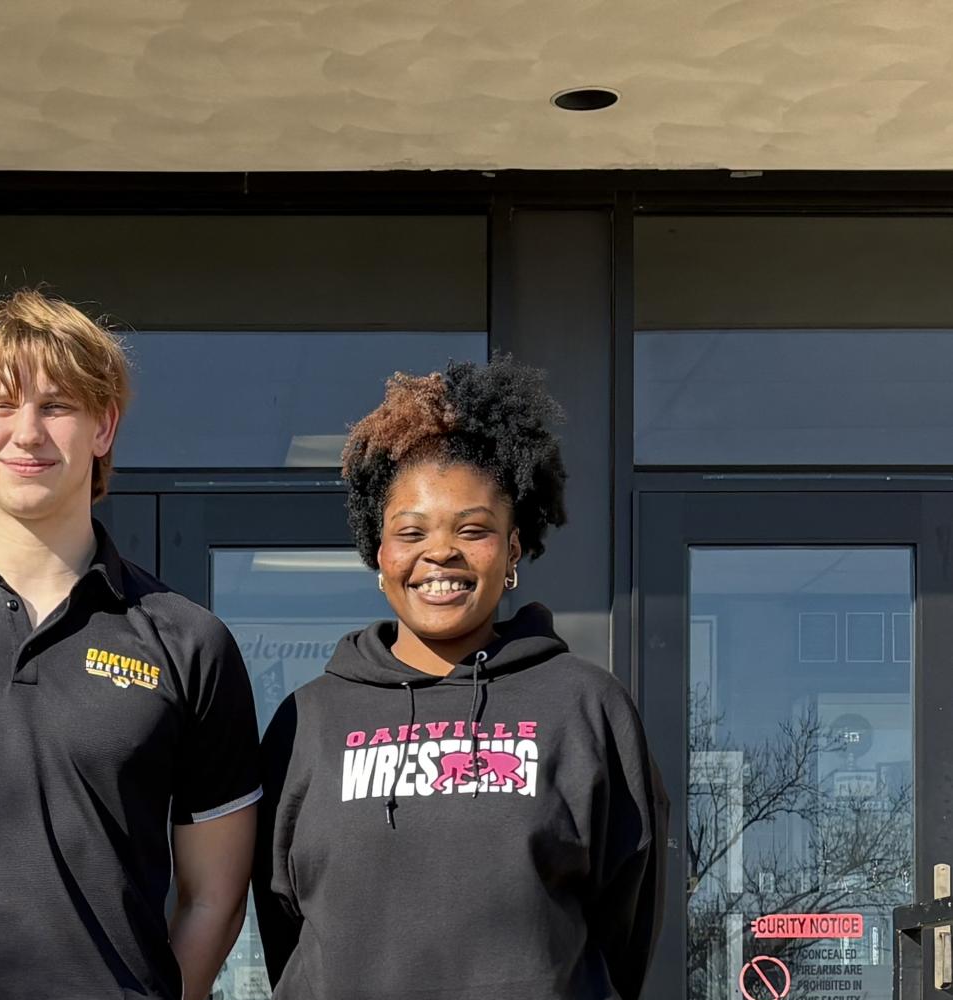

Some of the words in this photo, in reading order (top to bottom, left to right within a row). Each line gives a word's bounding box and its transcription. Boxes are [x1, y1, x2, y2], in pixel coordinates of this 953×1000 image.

[87, 648, 160, 678] OAKVILLE
[85, 659, 159, 685] WRESTLING
[346, 721, 538, 748] OAKVILLE
[810, 918, 860, 934] NOTICE
[801, 948, 857, 960] CONCEALED
[797, 964, 843, 976] FIREARMS
[843, 964, 863, 976] ARE
[796, 980, 851, 991] PROHIBITED
[852, 980, 863, 991] IN
